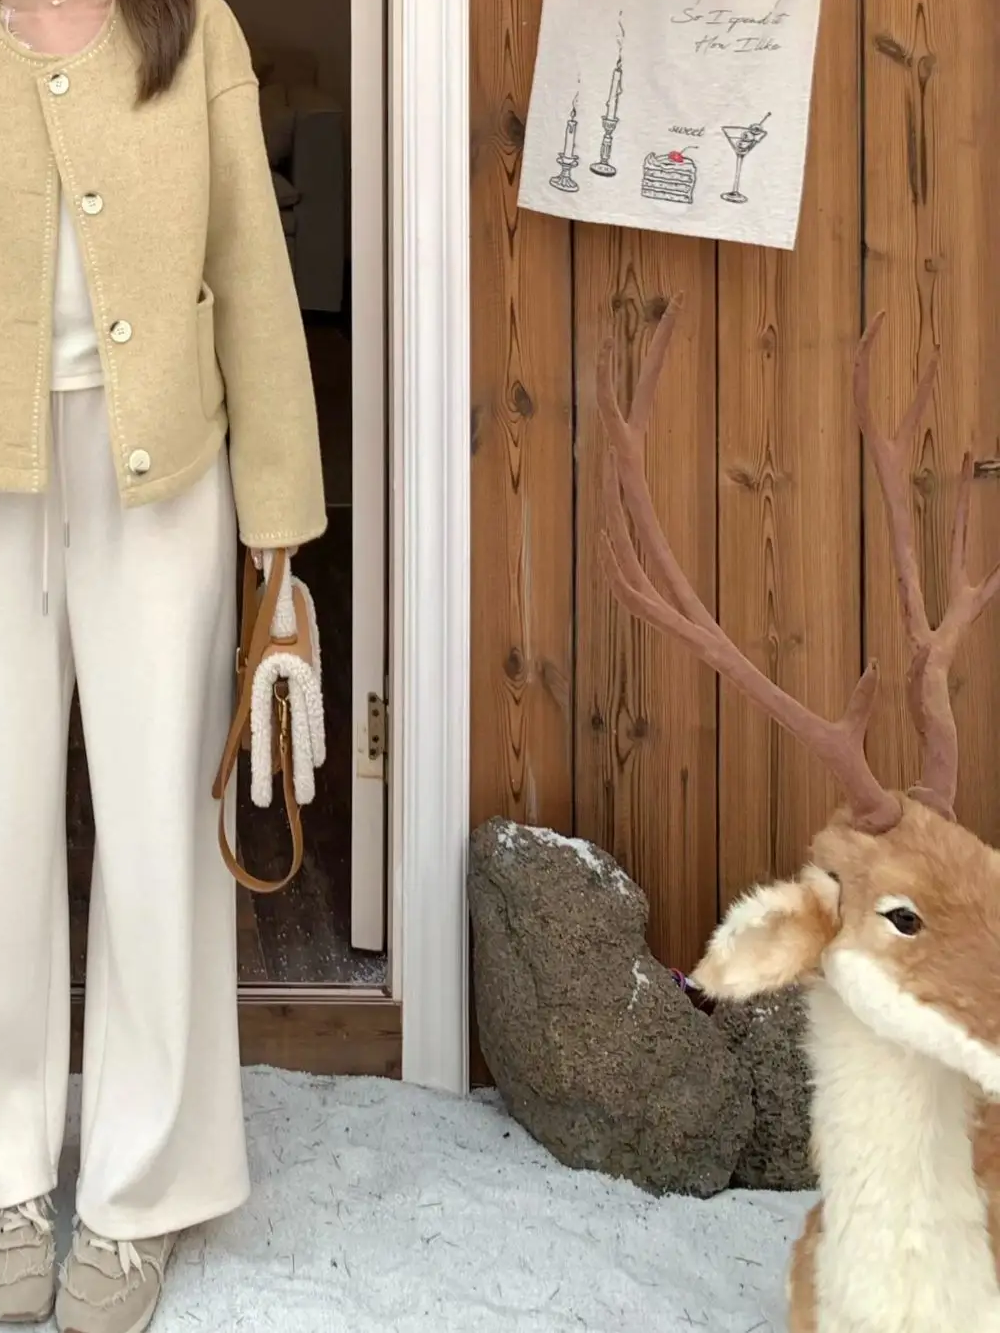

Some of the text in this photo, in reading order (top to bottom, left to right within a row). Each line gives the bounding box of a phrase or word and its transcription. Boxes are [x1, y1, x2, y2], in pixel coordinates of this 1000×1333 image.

[670, 8, 704, 23] So
[705, 10, 732, 25] I
[727, 11, 771, 33] spend
[694, 34, 782, 52] How I like
[668, 125, 706, 137] sweet
